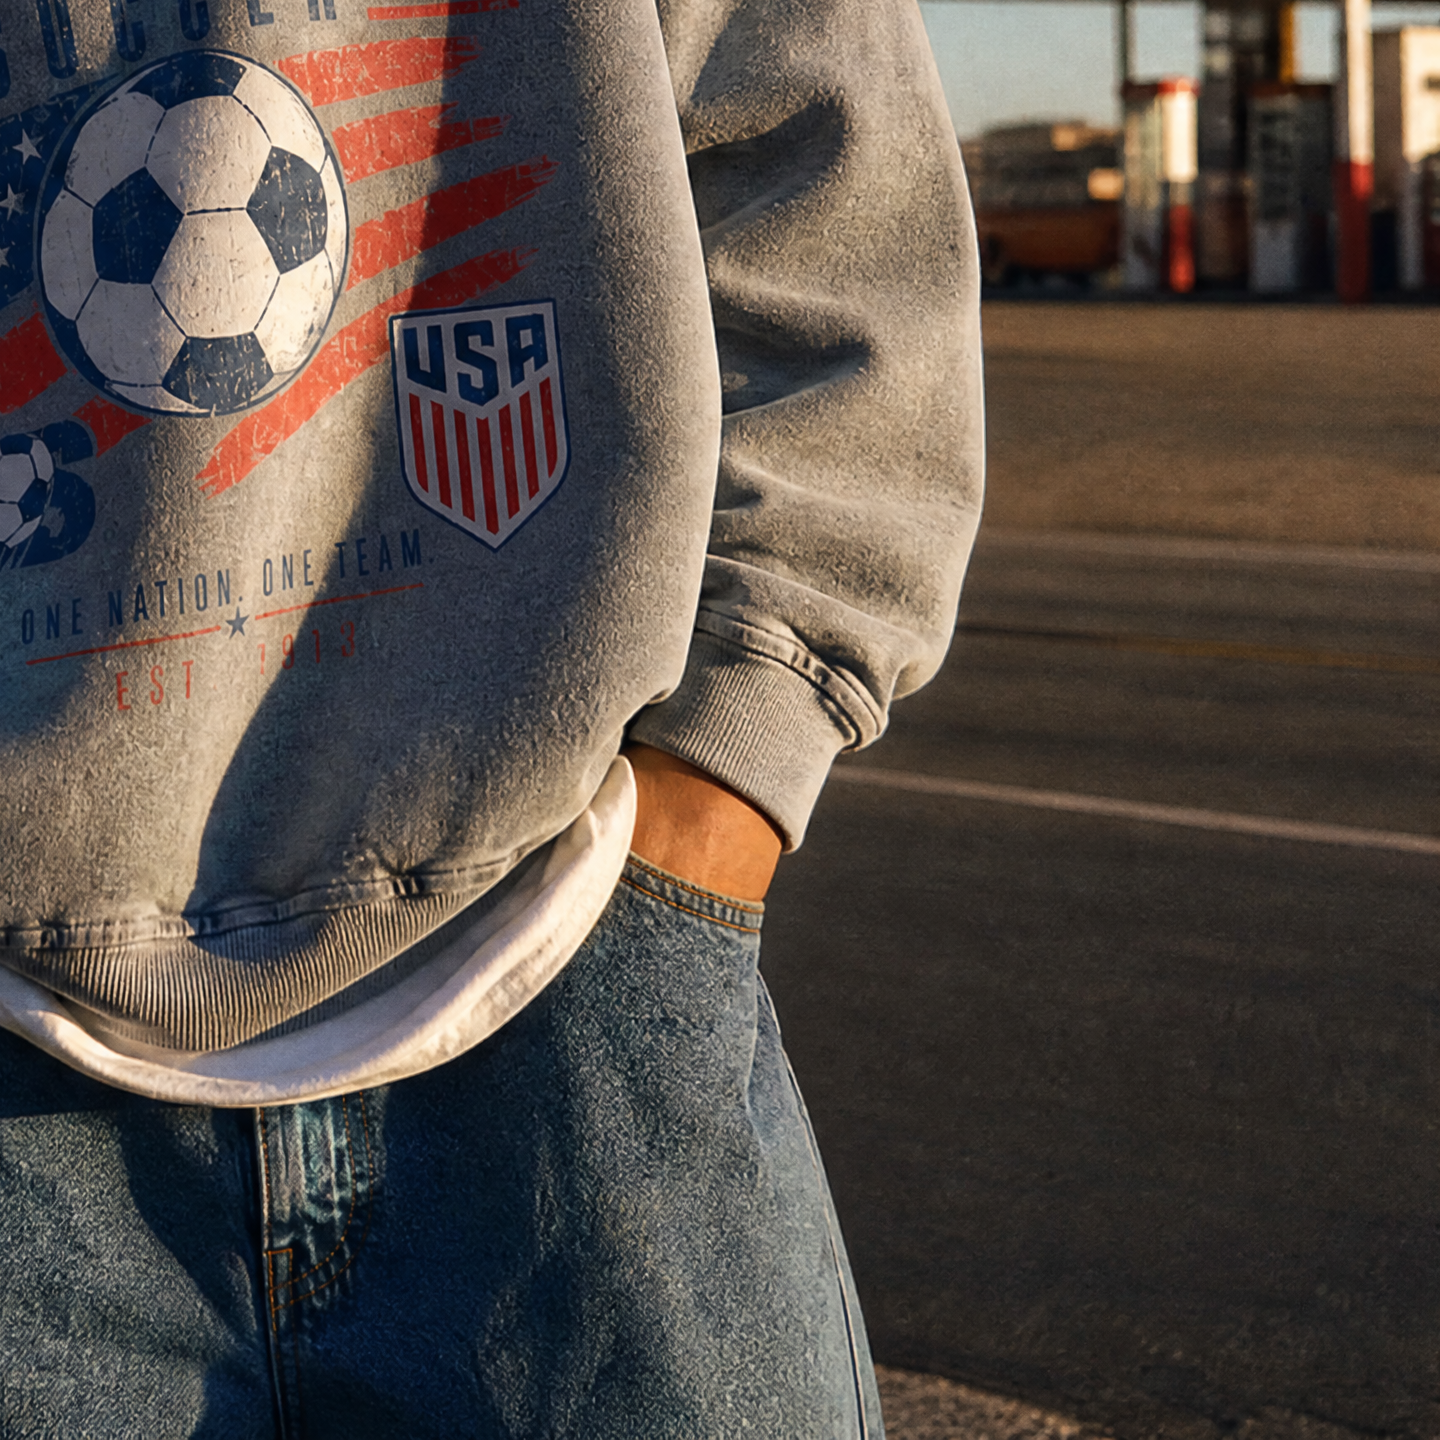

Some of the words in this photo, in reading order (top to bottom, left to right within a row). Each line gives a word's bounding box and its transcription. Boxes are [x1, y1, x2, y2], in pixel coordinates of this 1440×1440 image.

[402, 313, 549, 407] USA
[21, 597, 83, 644] ONE
[108, 569, 244, 627] NATION.
[262, 549, 314, 596] ONE
[257, 620, 356, 675] 1913
